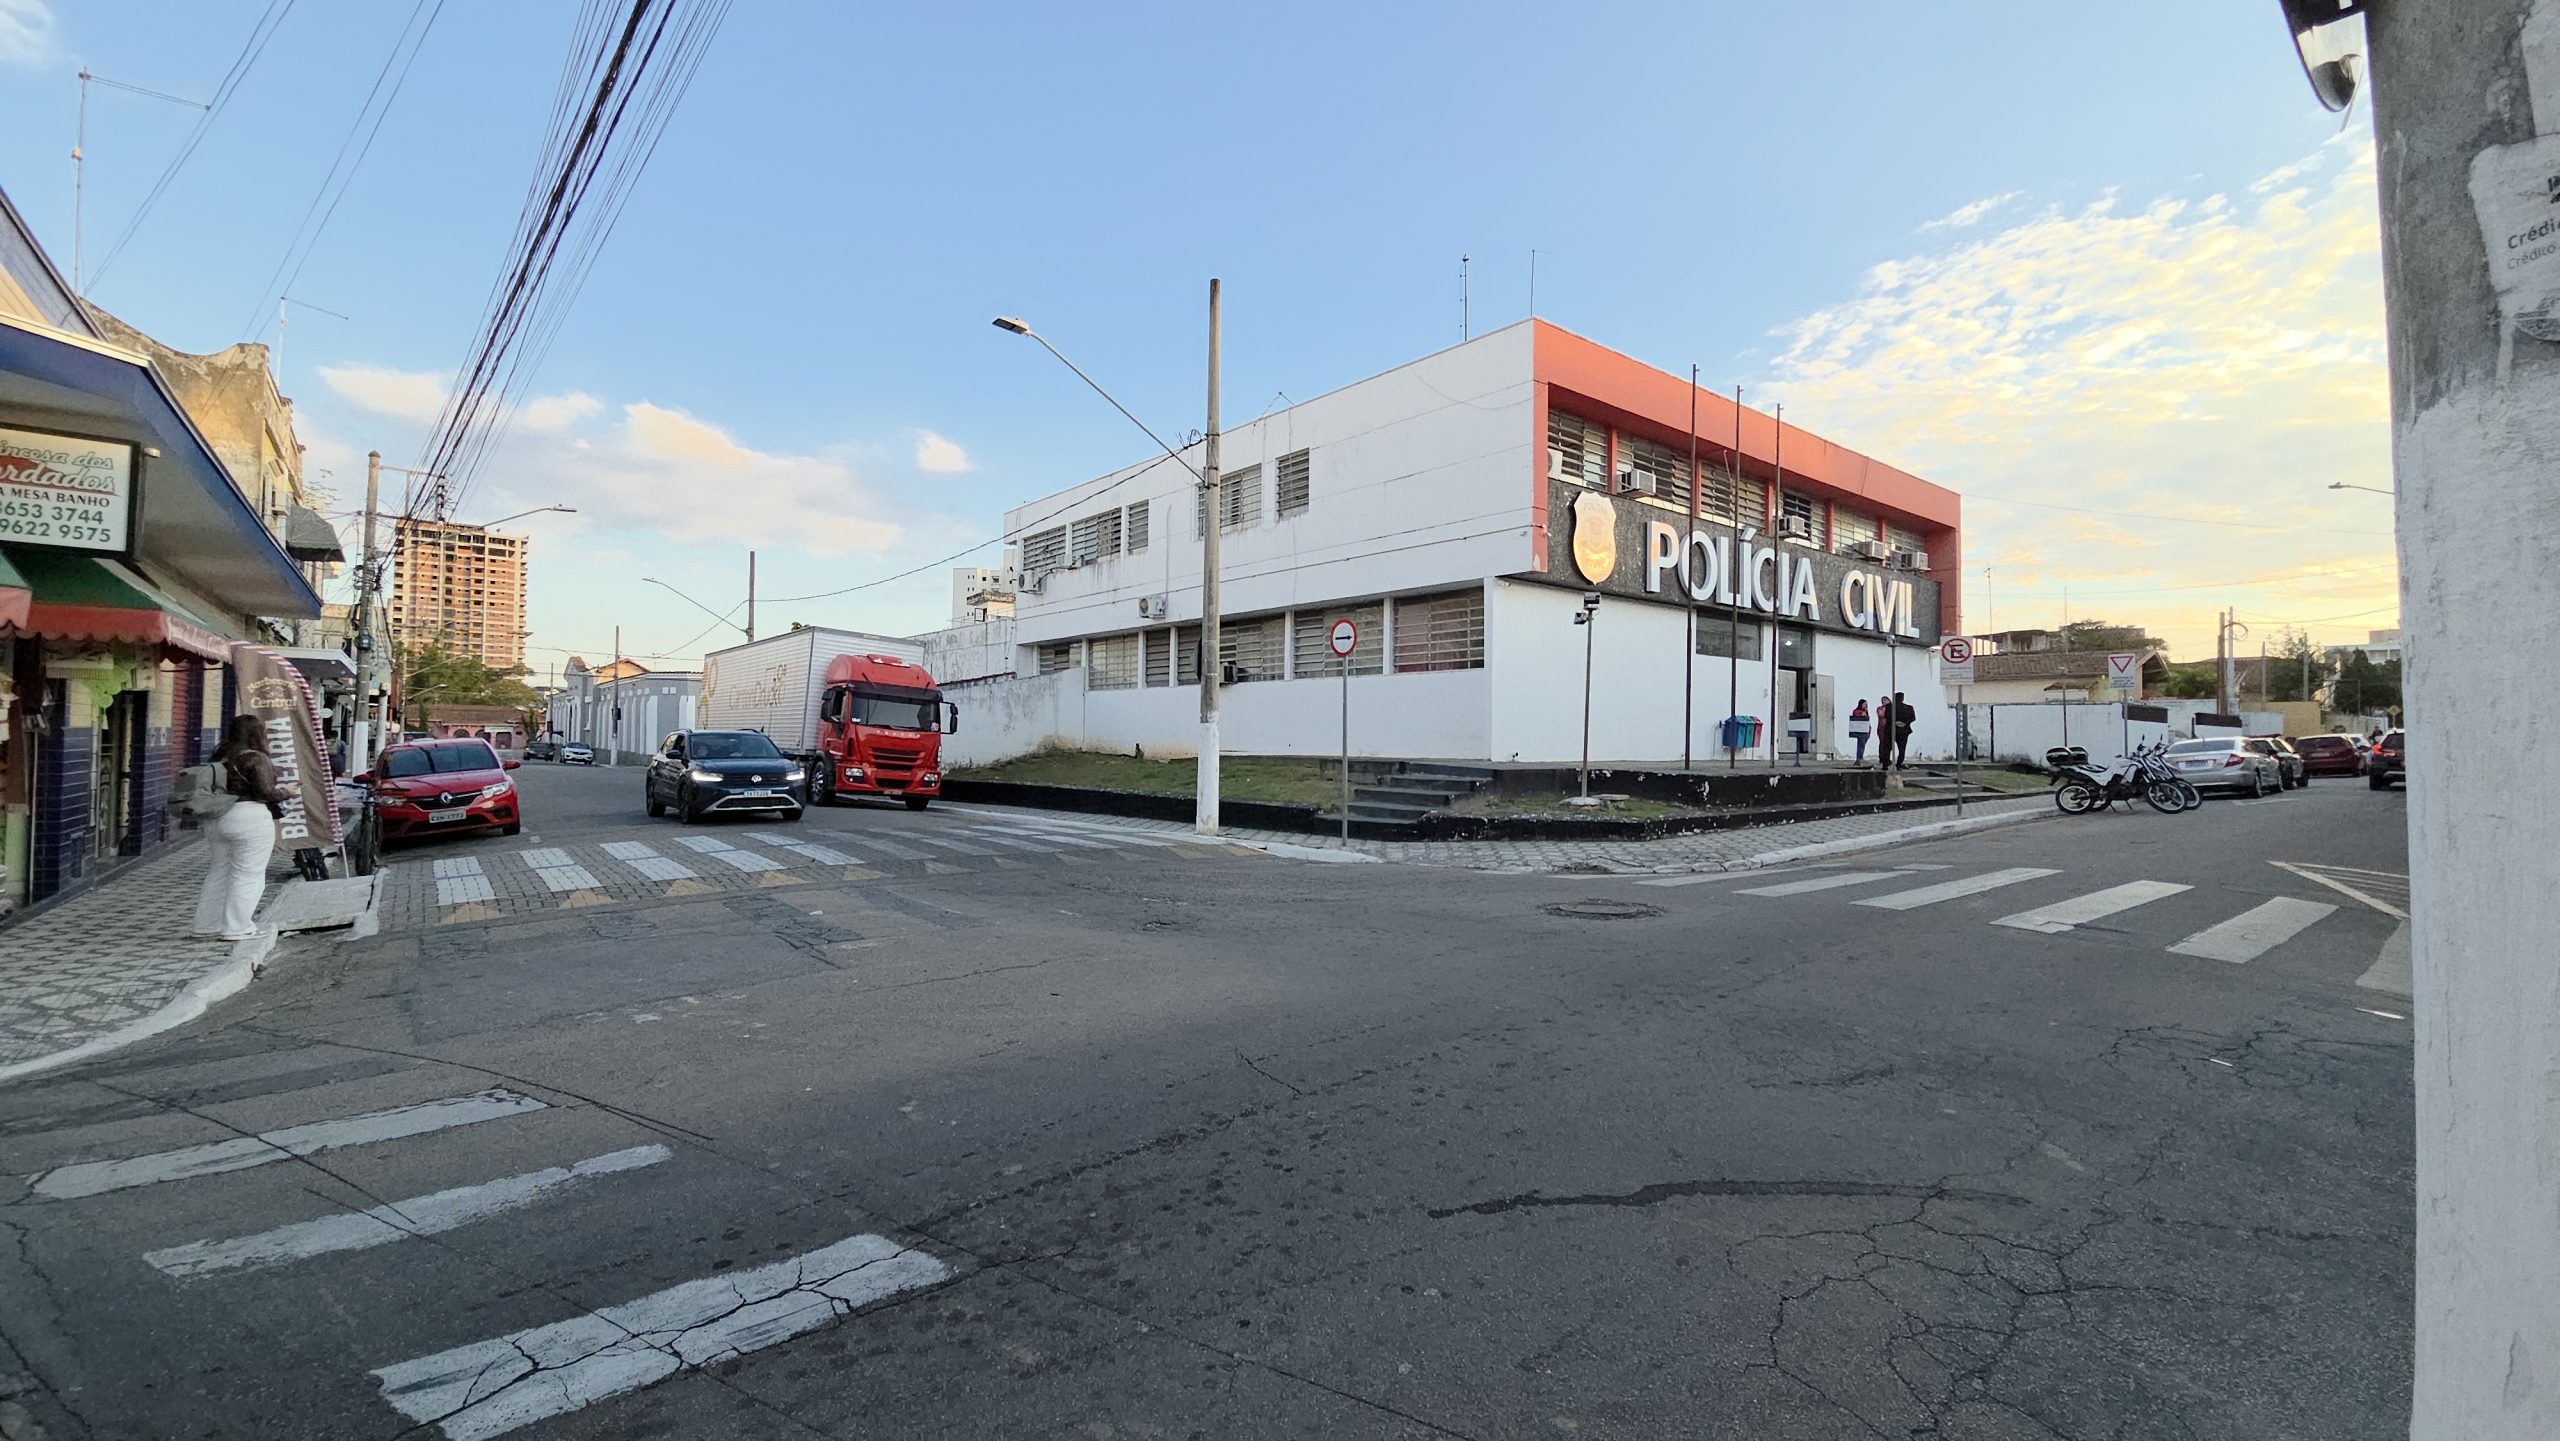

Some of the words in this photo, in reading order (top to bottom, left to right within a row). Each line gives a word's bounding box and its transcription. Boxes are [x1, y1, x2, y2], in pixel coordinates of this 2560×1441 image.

[71, 451, 114, 470] dos
[0, 460, 115, 493] rdados
[10, 487, 50, 501] MESA
[56, 492, 110, 508] BANHO
[0, 501, 43, 519] 653
[51, 506, 104, 525] 3744
[0, 518, 50, 537] 9622
[59, 524, 111, 543] 9575
[1646, 520, 1820, 621] POLÍCIA
[1840, 569, 1920, 639] CIVIL
